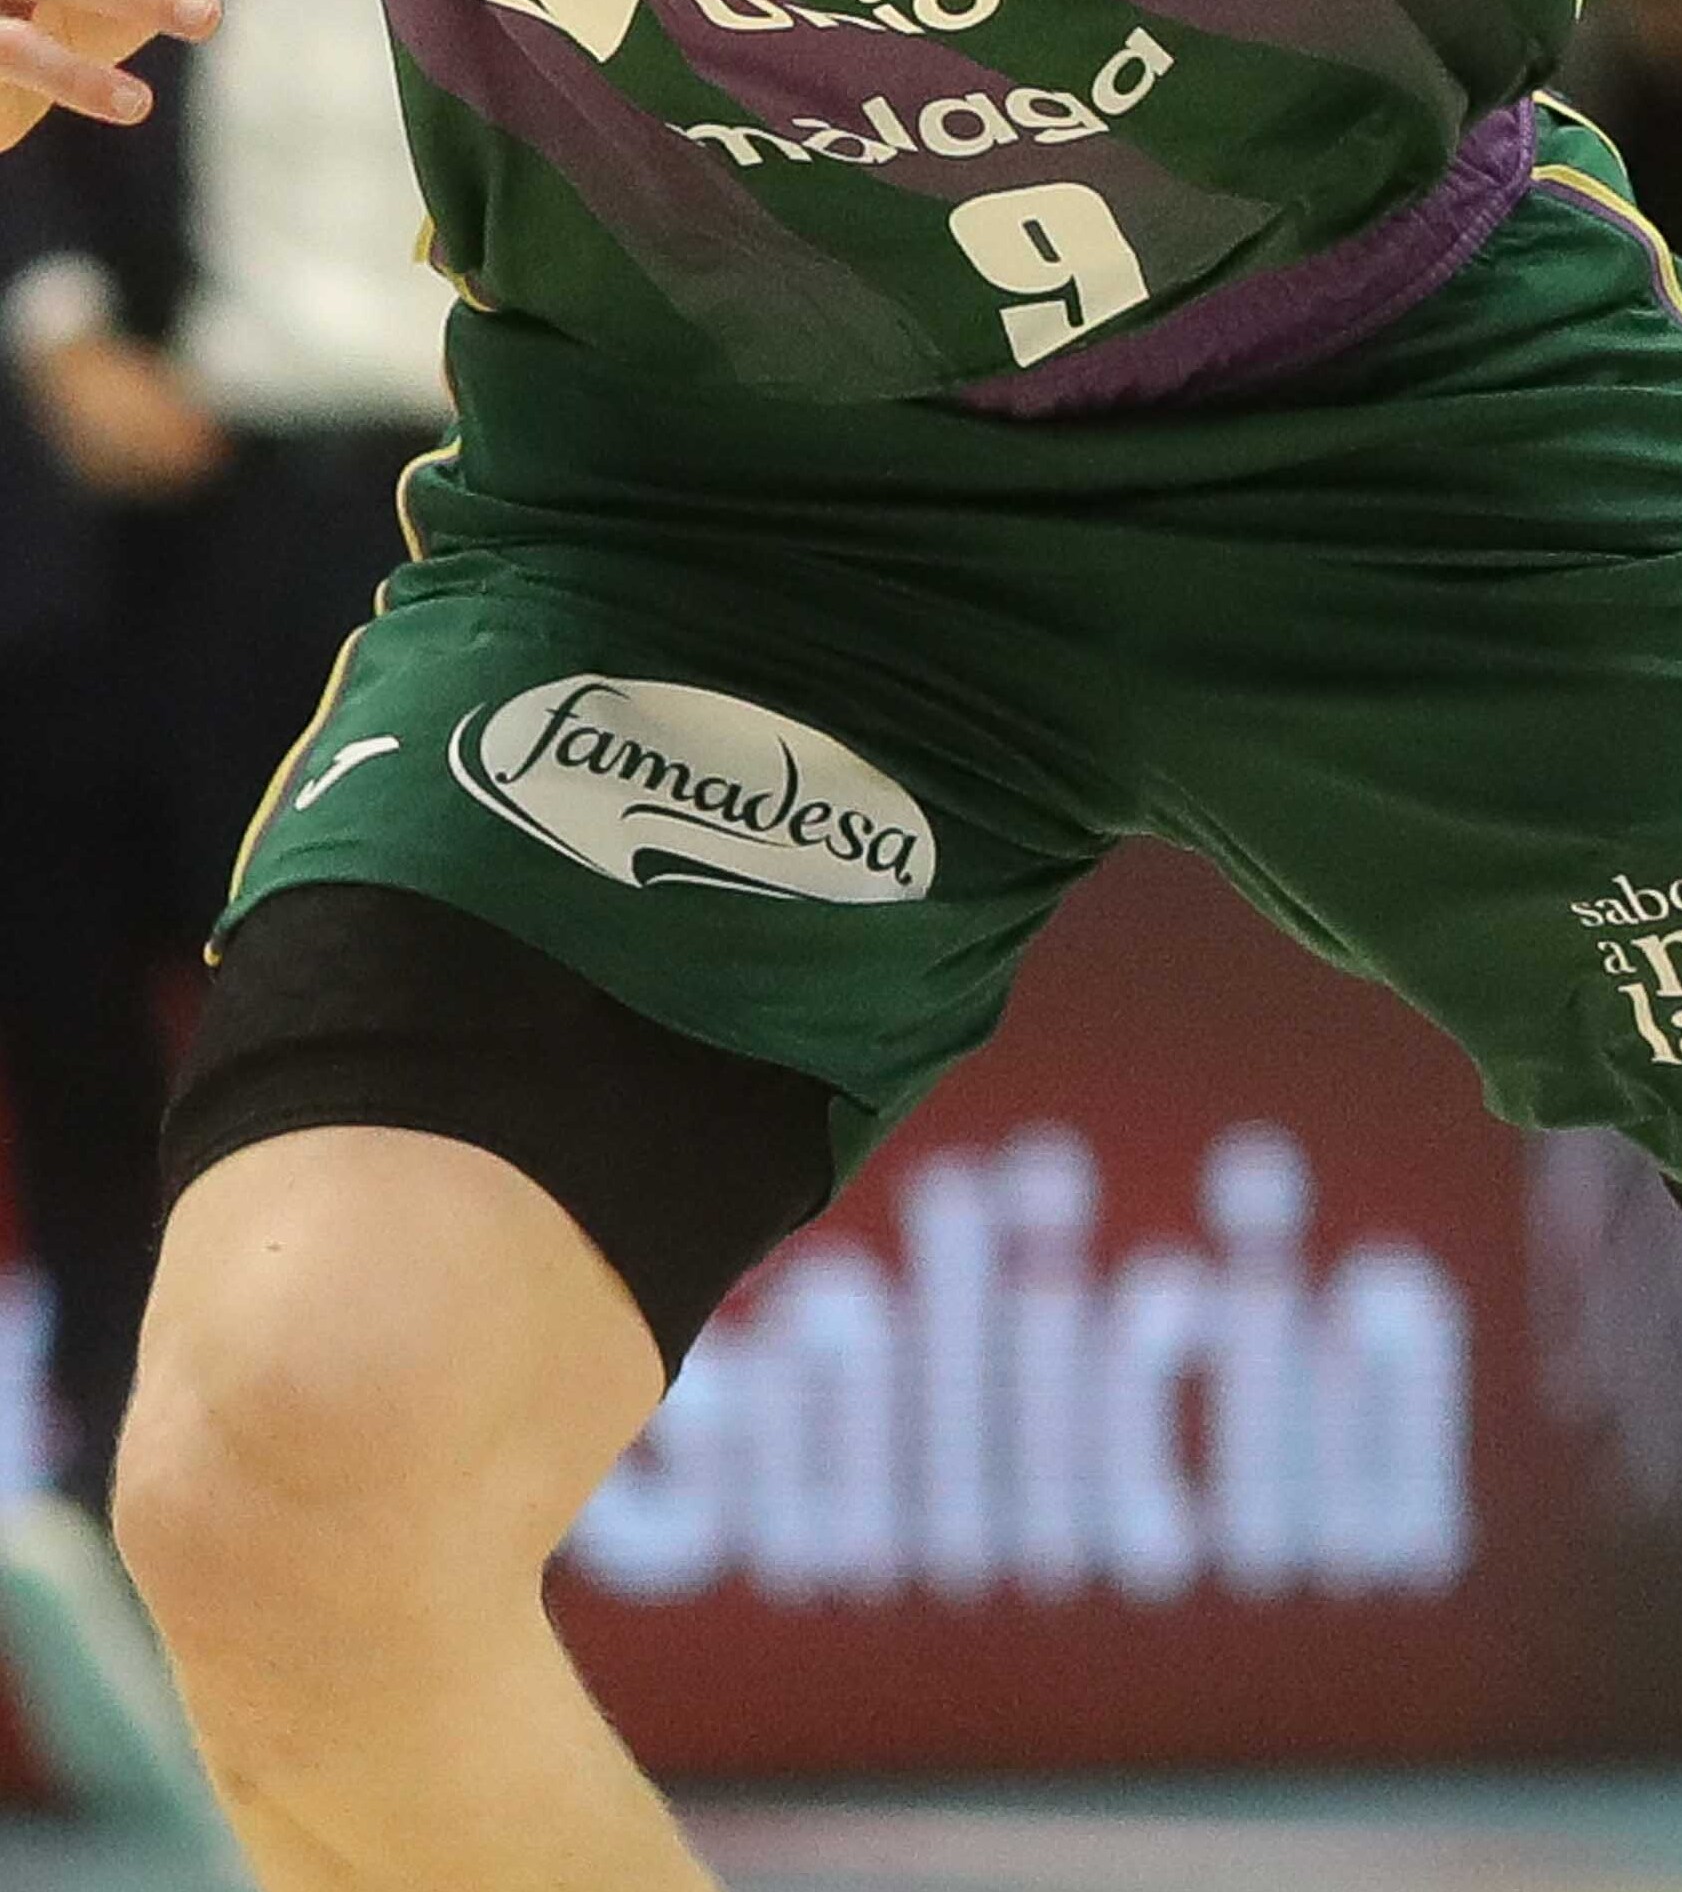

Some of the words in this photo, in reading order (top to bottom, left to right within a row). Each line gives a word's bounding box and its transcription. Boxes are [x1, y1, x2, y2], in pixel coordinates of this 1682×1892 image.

[948, 182, 1150, 368] 9
[495, 682, 918, 887] famadesa
[1597, 940, 1637, 976] a
